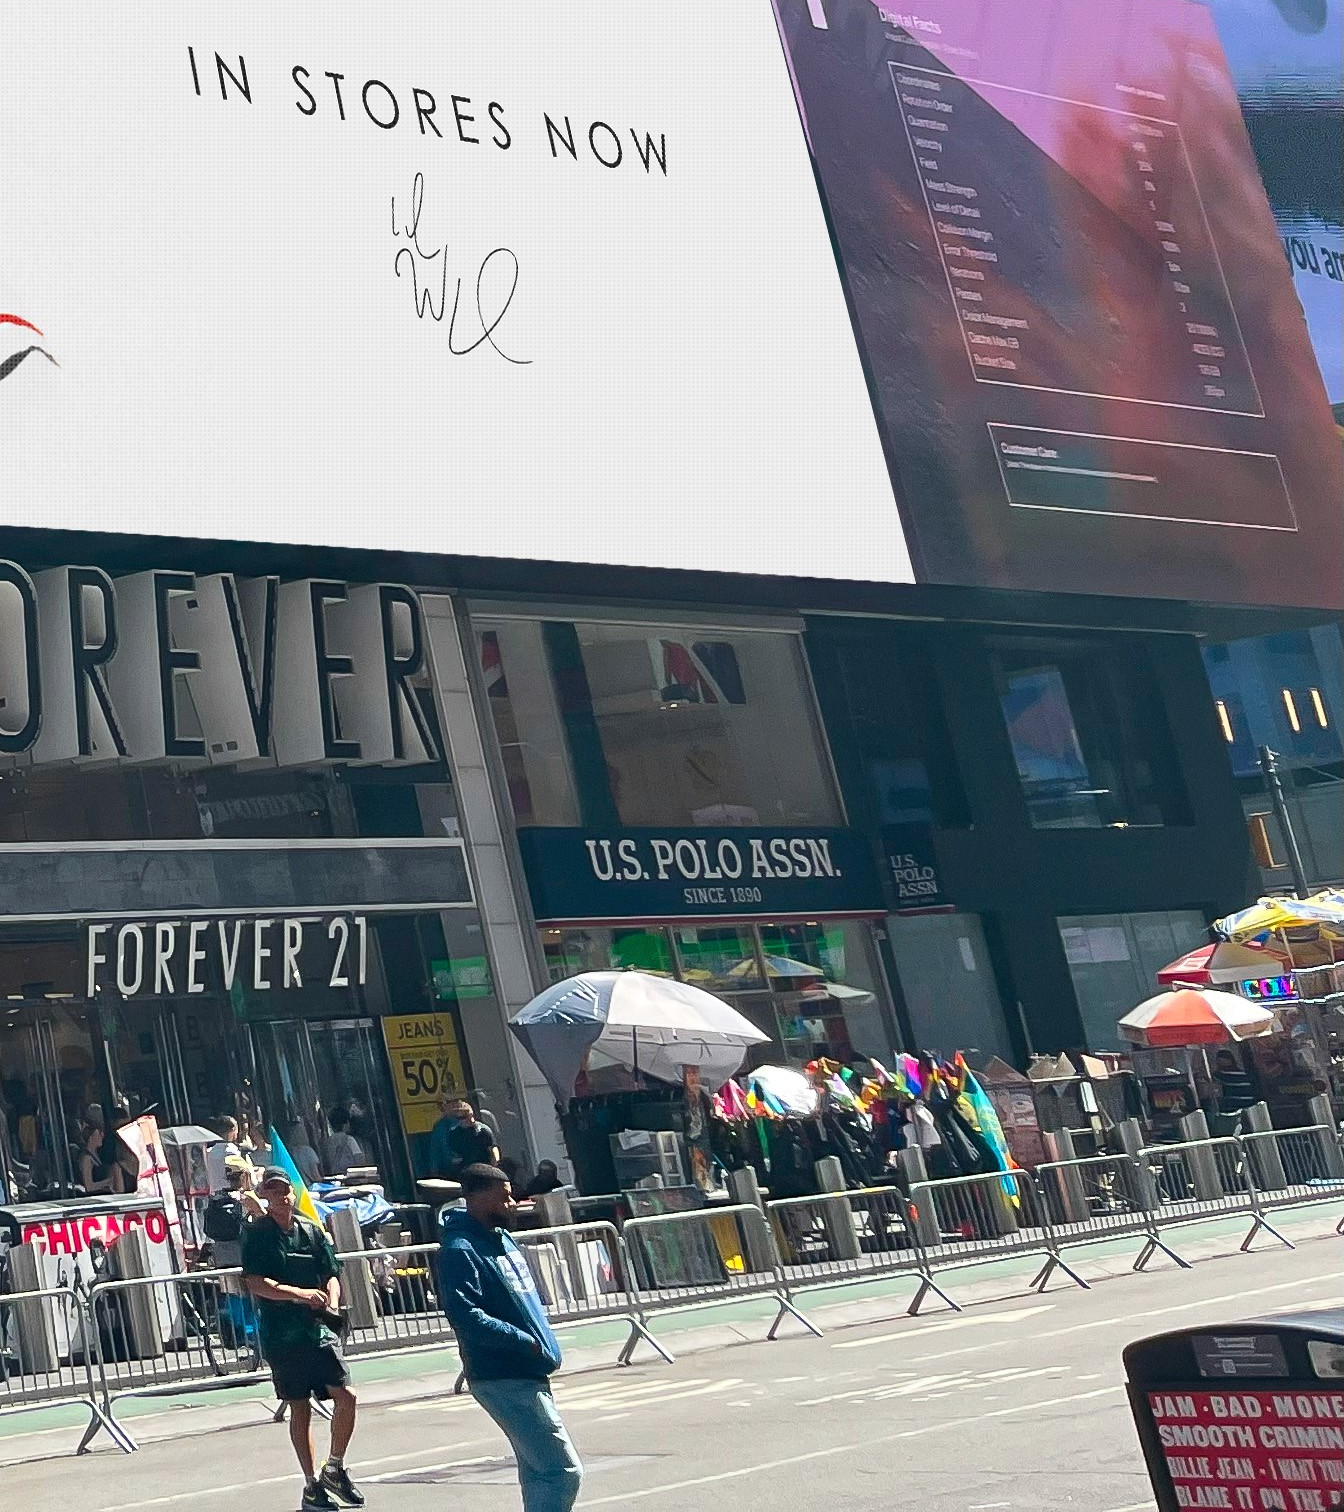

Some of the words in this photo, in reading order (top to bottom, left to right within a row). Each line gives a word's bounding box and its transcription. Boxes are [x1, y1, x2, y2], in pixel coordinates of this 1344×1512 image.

[188, 46, 252, 105] IN
[291, 65, 512, 151] STORES
[543, 111, 667, 177] NOW
[585, 838, 649, 881] U.S.
[652, 838, 743, 881] POLO
[749, 838, 841, 878] ASSN.
[893, 867, 935, 883] POLO
[684, 888, 727, 904] SINCE
[732, 886, 762, 903] 1890
[87, 918, 303, 999] FOREVER
[328, 916, 366, 986] 21
[397, 1020, 445, 1040] JEANS
[402, 1057, 456, 1097] 50%
[1152, 1396, 1197, 1418] JAM
[1210, 1395, 1262, 1418] BAD
[1272, 1395, 1344, 1418] MONE
[1158, 1425, 1257, 1448] SMOOTH
[1259, 1426, 1344, 1450] CRIMIN
[1166, 1456, 1213, 1479] BILLIE
[1216, 1456, 1255, 1480] JEAN
[1277, 1458, 1317, 1482] WANT
[1174, 1485, 1234, 1509] BLAME
[1235, 1486, 1253, 1509] IT
[1259, 1487, 1287, 1511] ON
[1288, 1488, 1327, 1512] THE
